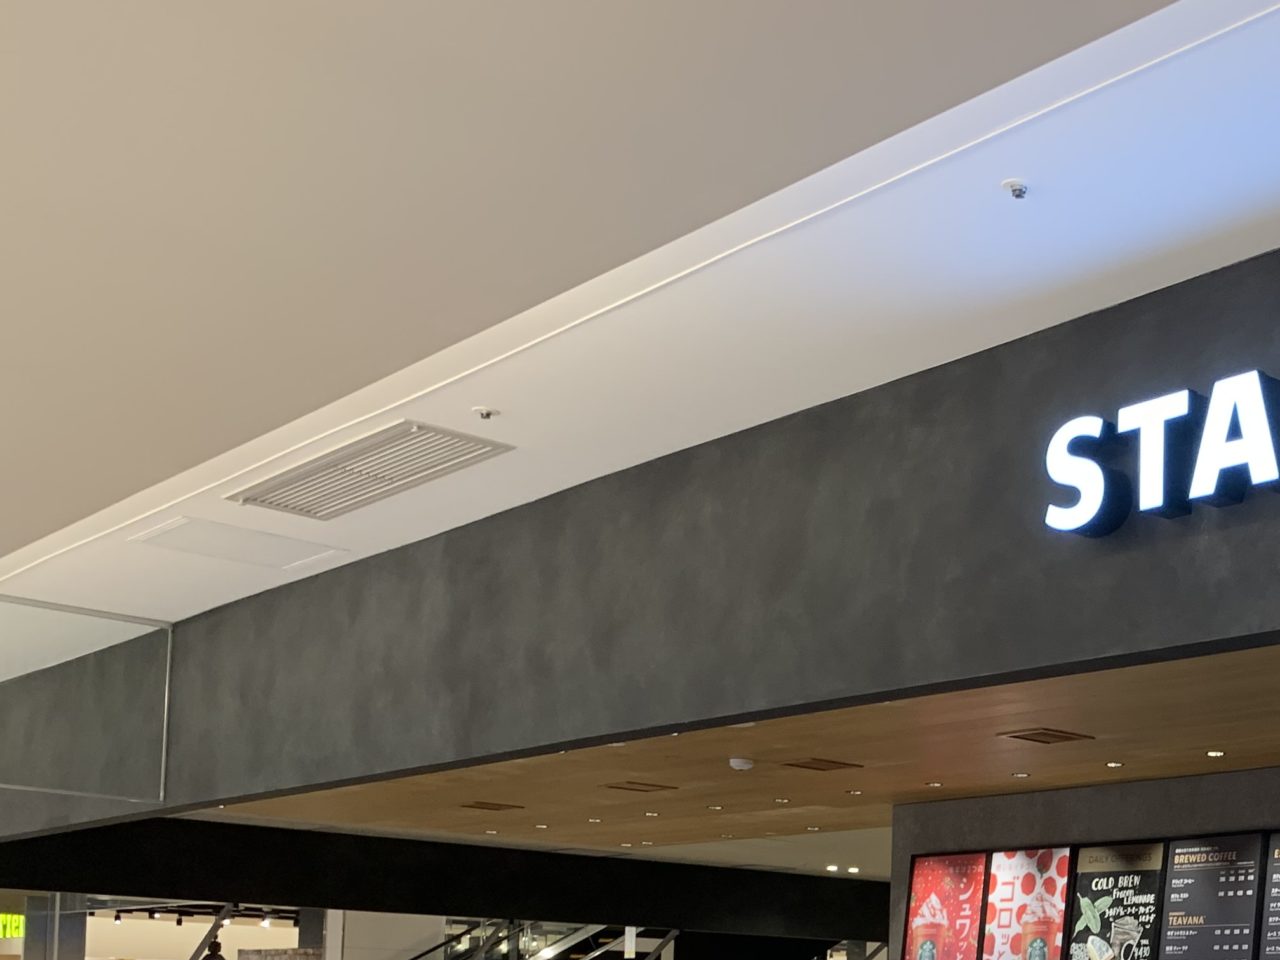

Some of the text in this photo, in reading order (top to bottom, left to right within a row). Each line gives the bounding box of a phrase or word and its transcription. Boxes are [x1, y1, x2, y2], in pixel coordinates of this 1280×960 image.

[1174, 851, 1237, 864] BREWED COFFEE
[1091, 875, 1141, 891] COLD BREW
[1123, 893, 1155, 905] LEMONADE
[1169, 916, 1205, 926] TEAVANA
